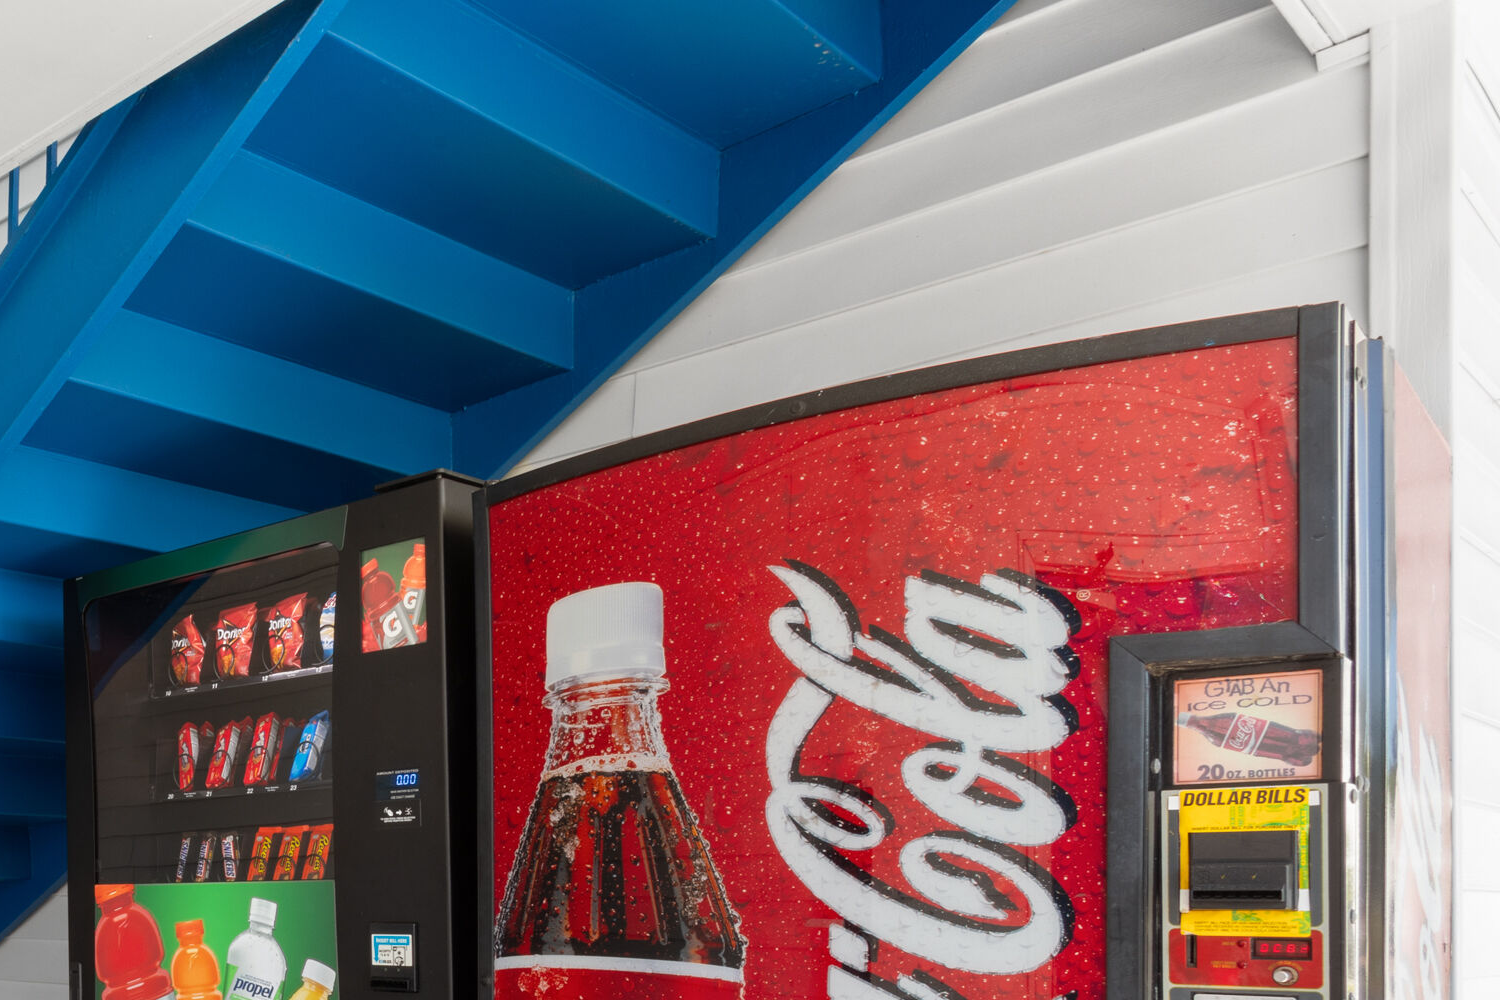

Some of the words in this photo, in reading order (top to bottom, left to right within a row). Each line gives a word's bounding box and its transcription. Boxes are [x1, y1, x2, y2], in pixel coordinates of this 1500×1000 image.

[403, 591, 418, 609] G
[383, 611, 402, 638] G
[1237, 694, 1313, 708] COLD
[1197, 764, 1225, 781] 20
[1248, 767, 1296, 779] BOTTLES
[1183, 791, 1252, 807] DOLLAR
[1256, 788, 1306, 804] BILLS
[233, 977, 274, 998] propel
